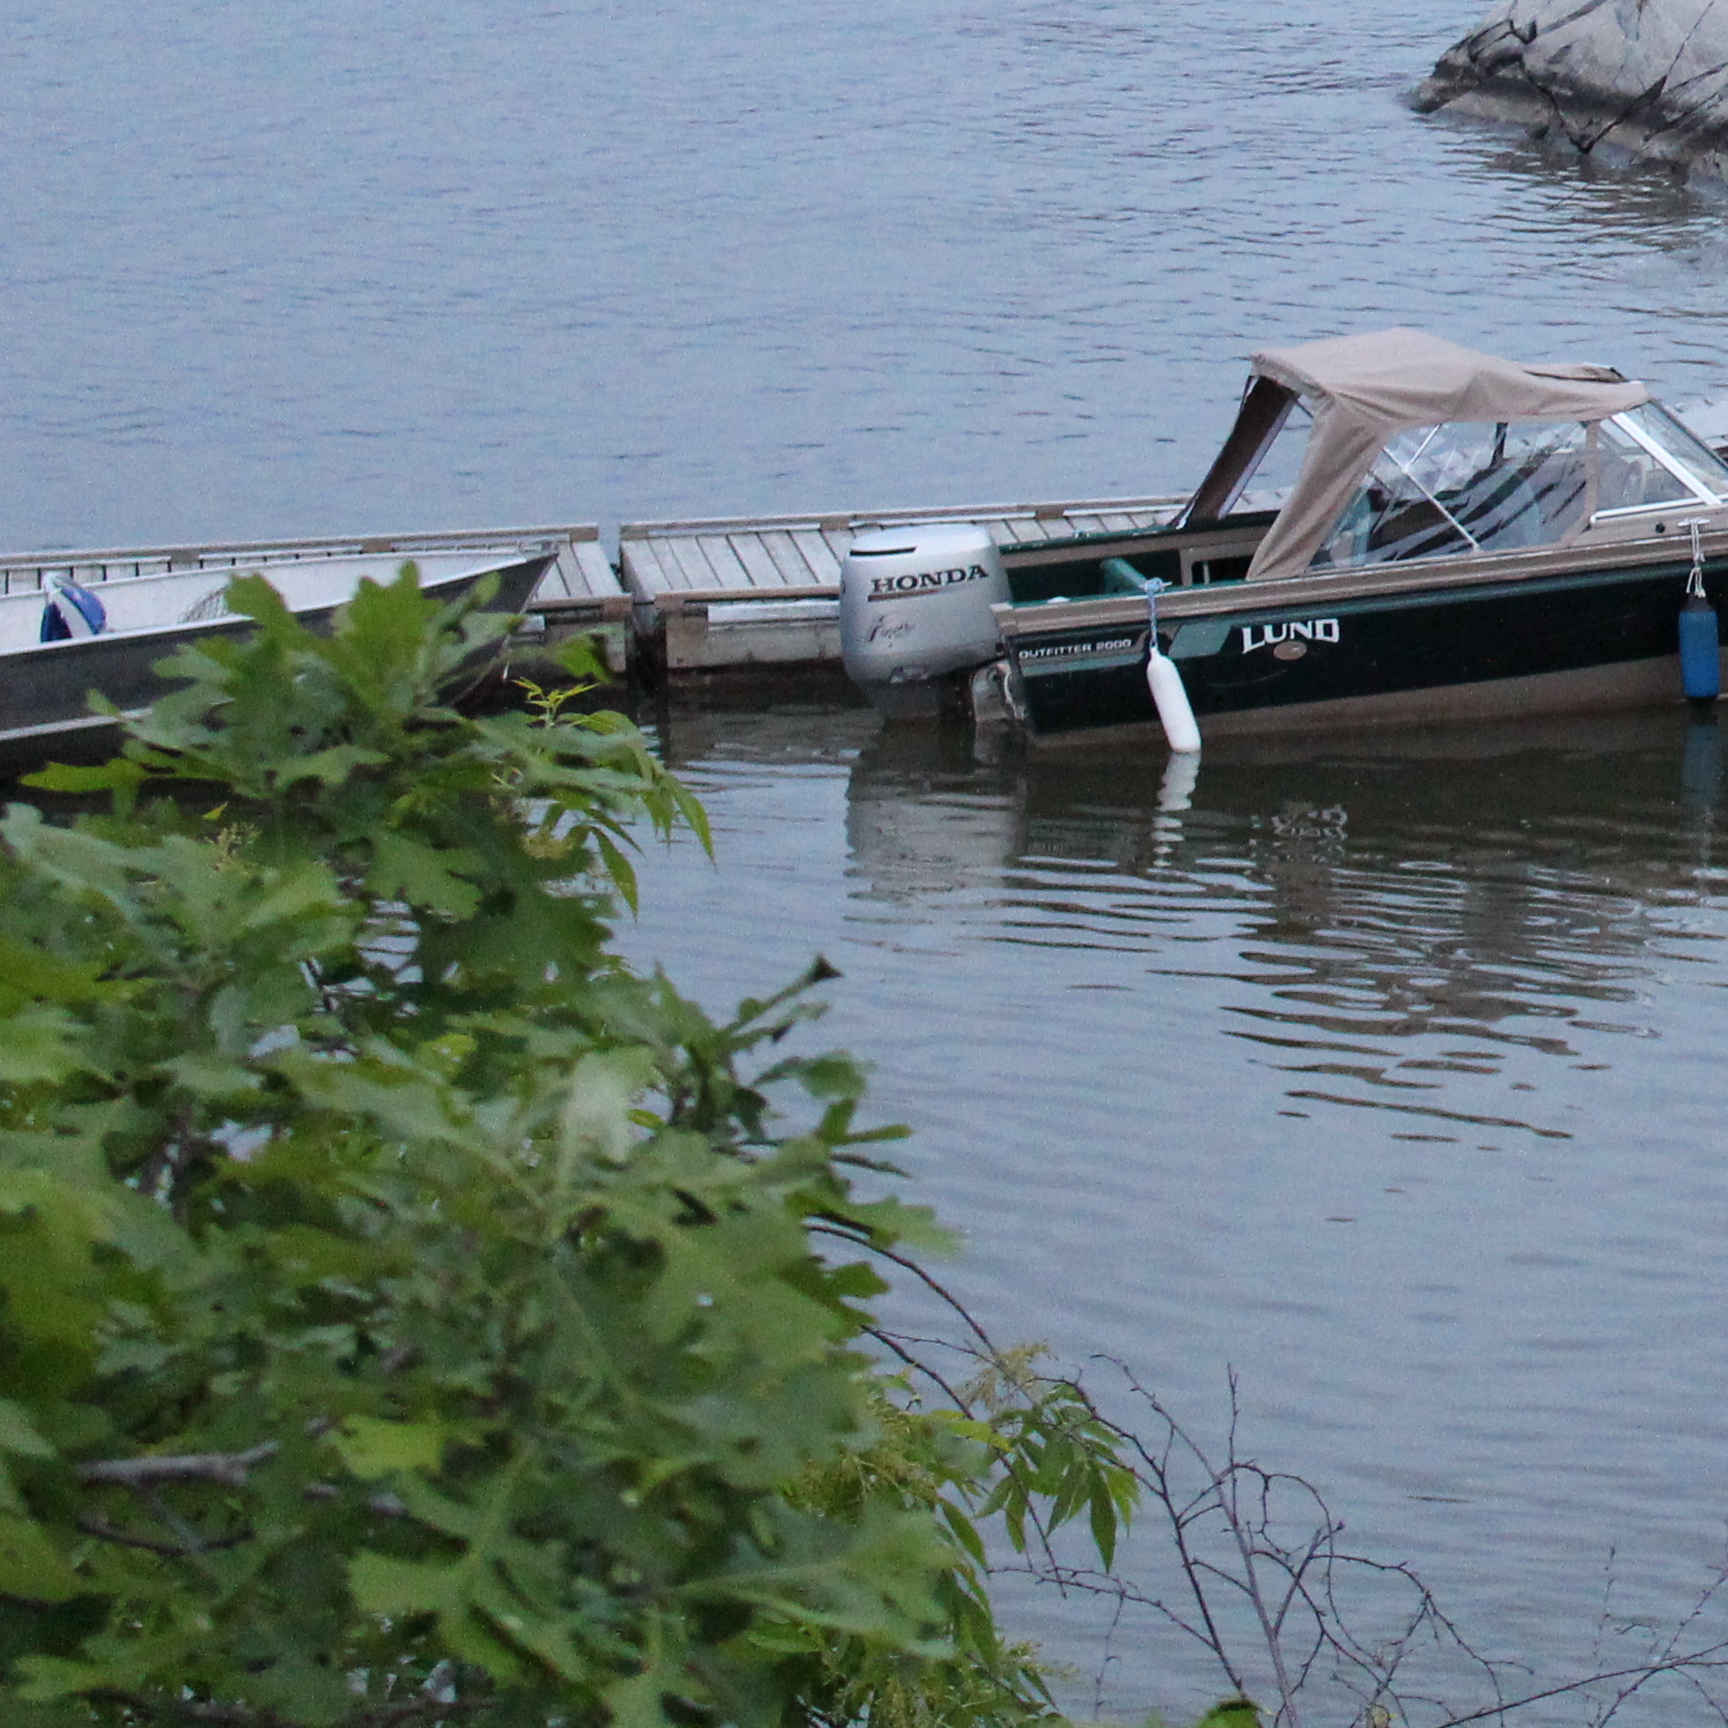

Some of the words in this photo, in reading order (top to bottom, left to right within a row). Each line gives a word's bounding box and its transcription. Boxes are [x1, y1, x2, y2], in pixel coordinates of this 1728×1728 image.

[871, 564, 989, 592] HONDA
[1241, 618, 1340, 654] LUND
[1019, 643, 1092, 659] OUTFITTER
